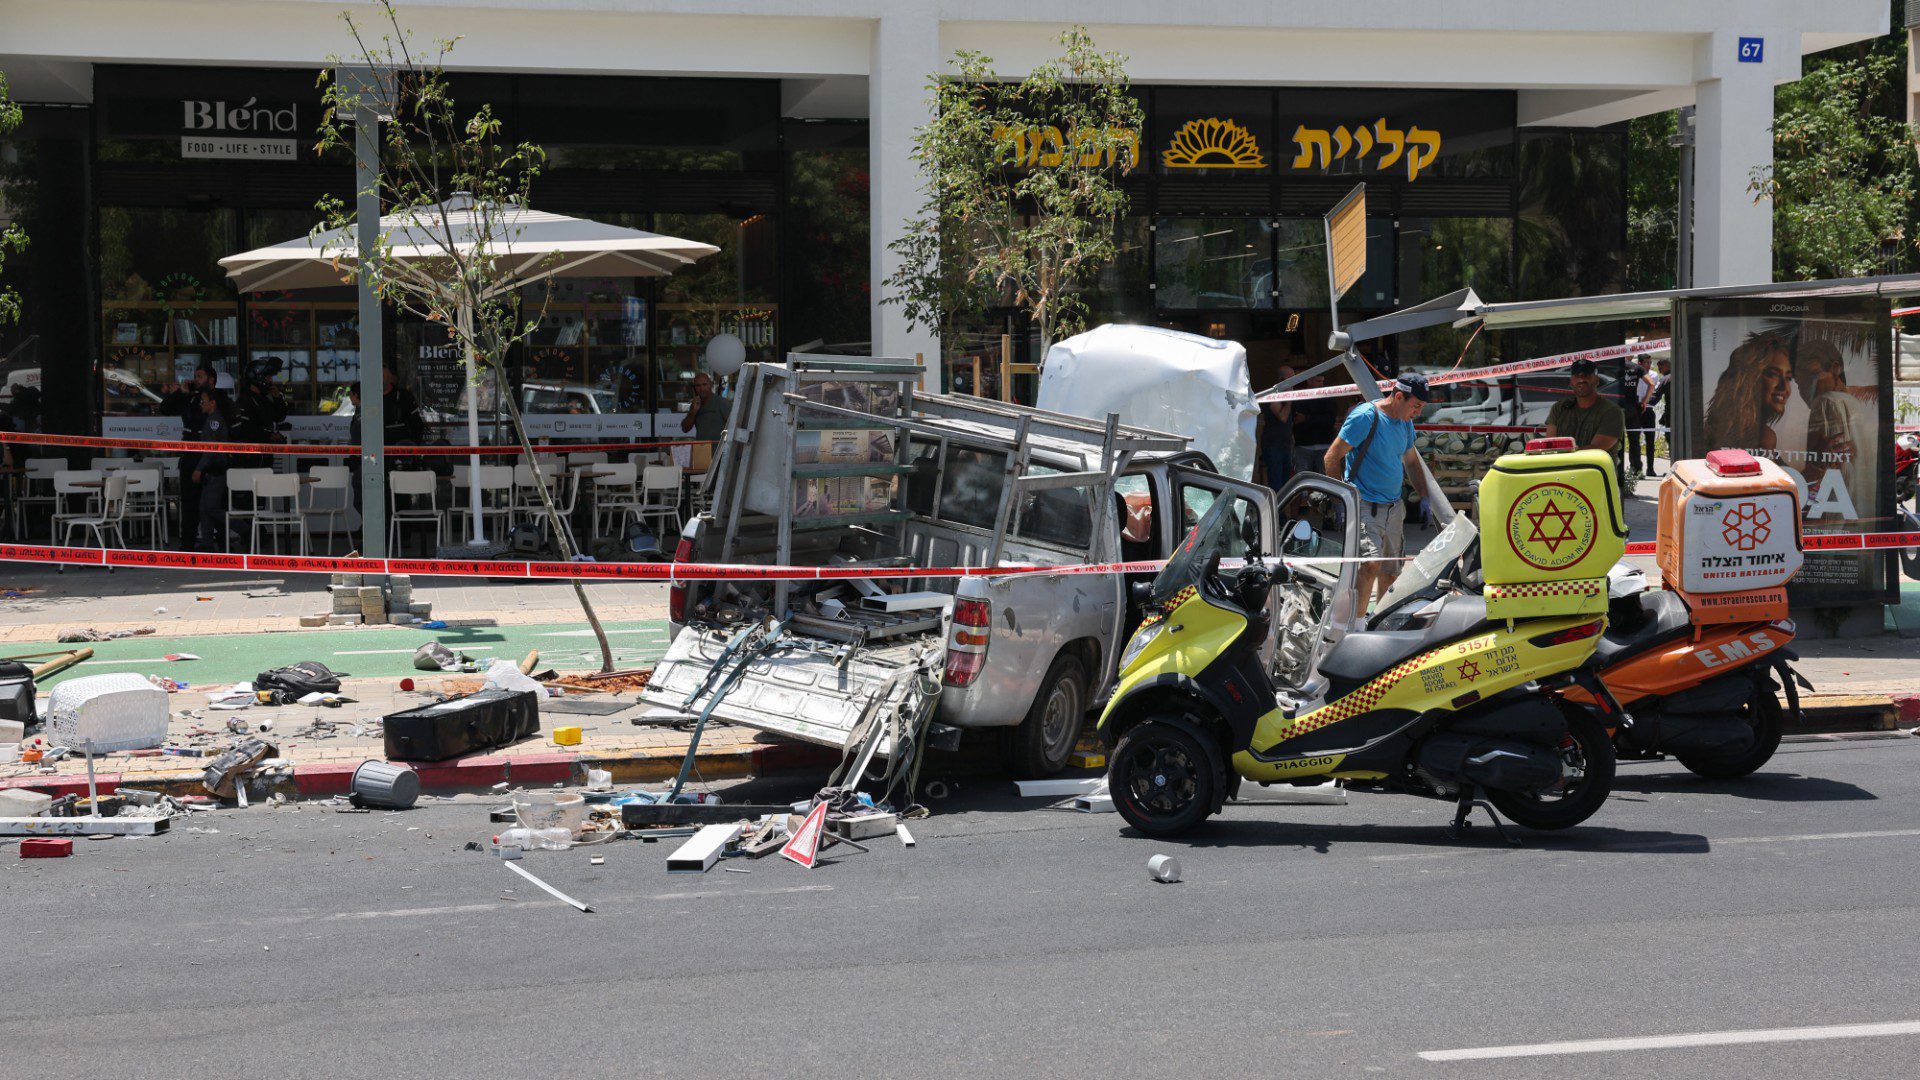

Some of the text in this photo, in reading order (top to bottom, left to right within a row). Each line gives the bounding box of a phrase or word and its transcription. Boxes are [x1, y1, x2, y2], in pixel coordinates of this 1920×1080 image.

[1741, 42, 1761, 57] 67
[181, 96, 297, 131] Blénd
[187, 142, 291, 155] FOOD LIFE STYLE
[1291, 117, 1441, 182] קליית
[1769, 304, 1810, 313] JCDecaux
[1784, 450, 1818, 463] הדרך
[1821, 453, 1852, 464] זאת
[1513, 488, 1589, 518] מגן דוד אדום בישראל
[1693, 504, 1714, 513] הראל
[1512, 518, 1592, 566] MAGEN DAVID ADOM IN ISRAEL
[112, 553, 238, 566] משטרת ישראל אין מעבר
[252, 558, 379, 570] משטרת ישראל אין מעבר
[1702, 553, 1785, 568] איחוד הצלה
[393, 562, 521, 573] משטרת ישראל אין מעבר
[536, 565, 568, 573] משטרת
[585, 565, 612, 575] ישראל
[1125, 563, 1157, 572] משטרת
[1703, 568, 1785, 579] UNITED HATZALAH
[1701, 594, 1782, 607] www.israelrescue.org
[1458, 637, 1490, 654] 5157
[1694, 632, 1776, 668] E.M.S
[1484, 645, 1515, 660] מגן דוד
[1496, 654, 1518, 664] אדום
[1420, 665, 1445, 676] MAGEN
[1421, 672, 1443, 682] DAVID
[1485, 663, 1520, 678] בישראל
[1424, 678, 1445, 688] ADOM
[1425, 682, 1457, 693] IN ISRAEL
[1274, 756, 1333, 771] PIAGGIO
